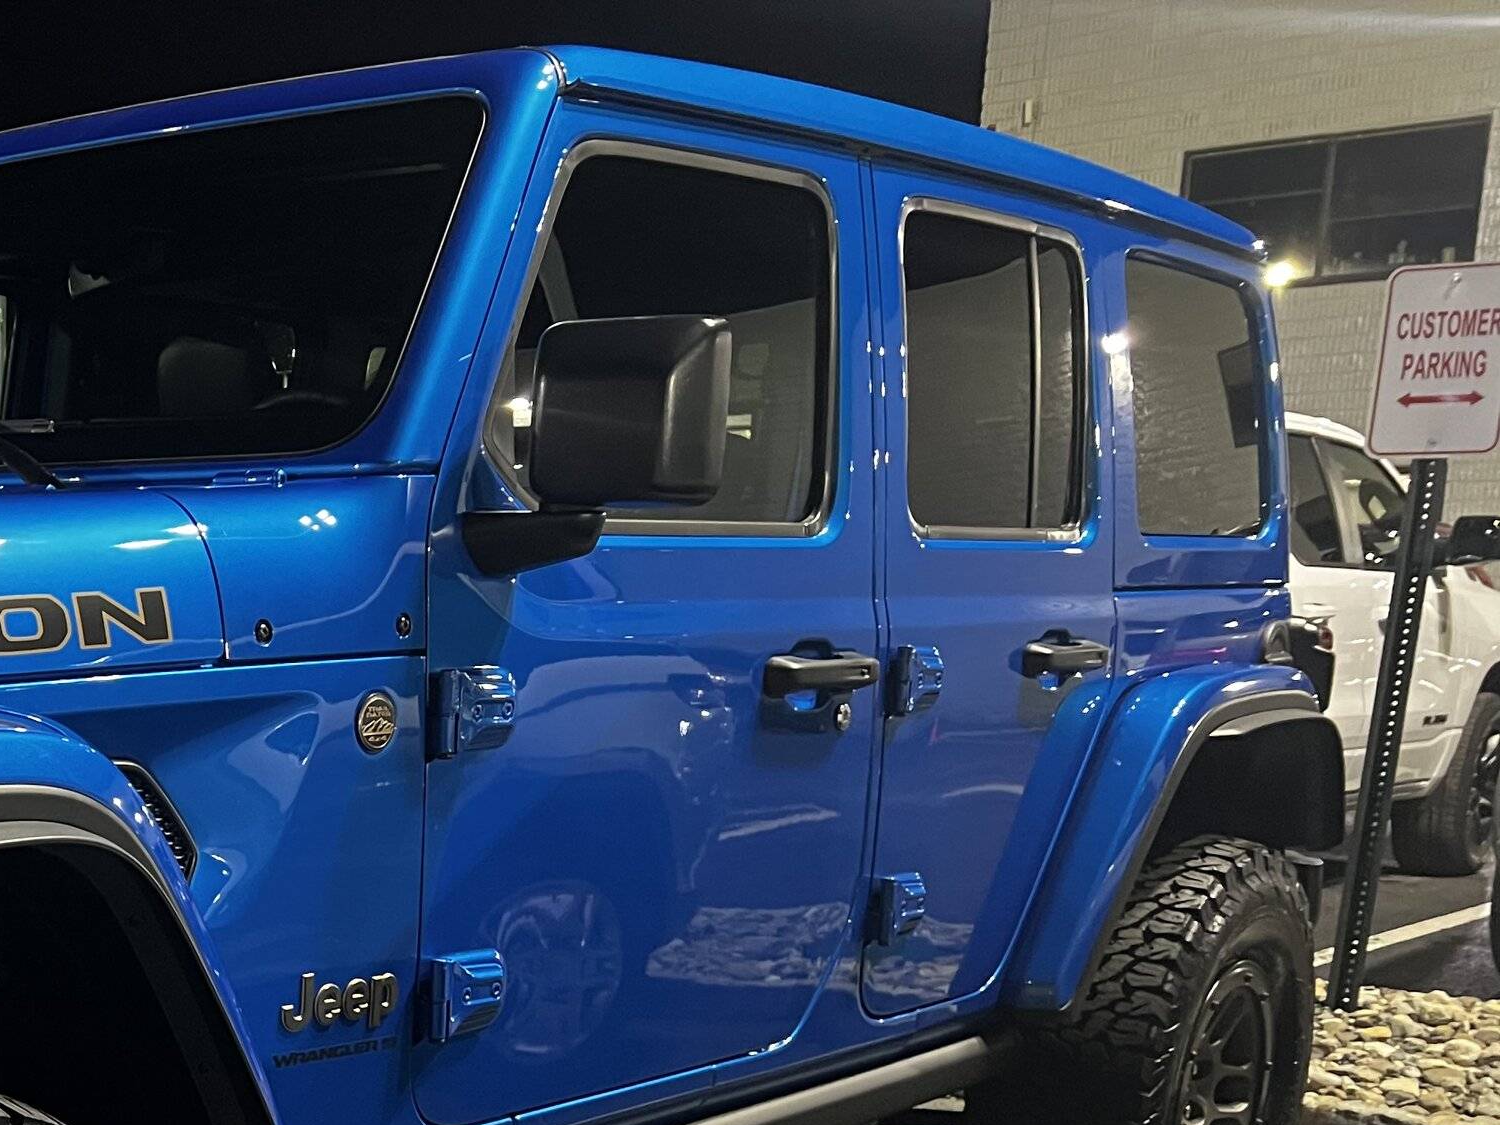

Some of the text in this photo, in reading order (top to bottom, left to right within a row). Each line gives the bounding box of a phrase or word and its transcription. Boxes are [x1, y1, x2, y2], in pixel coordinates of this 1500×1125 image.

[1396, 308, 1500, 340] CUSTOMER
[1400, 350, 1488, 380] PARKING
[281, 972, 400, 1032] Jeep
[273, 1040, 378, 1068] WRANGLER
